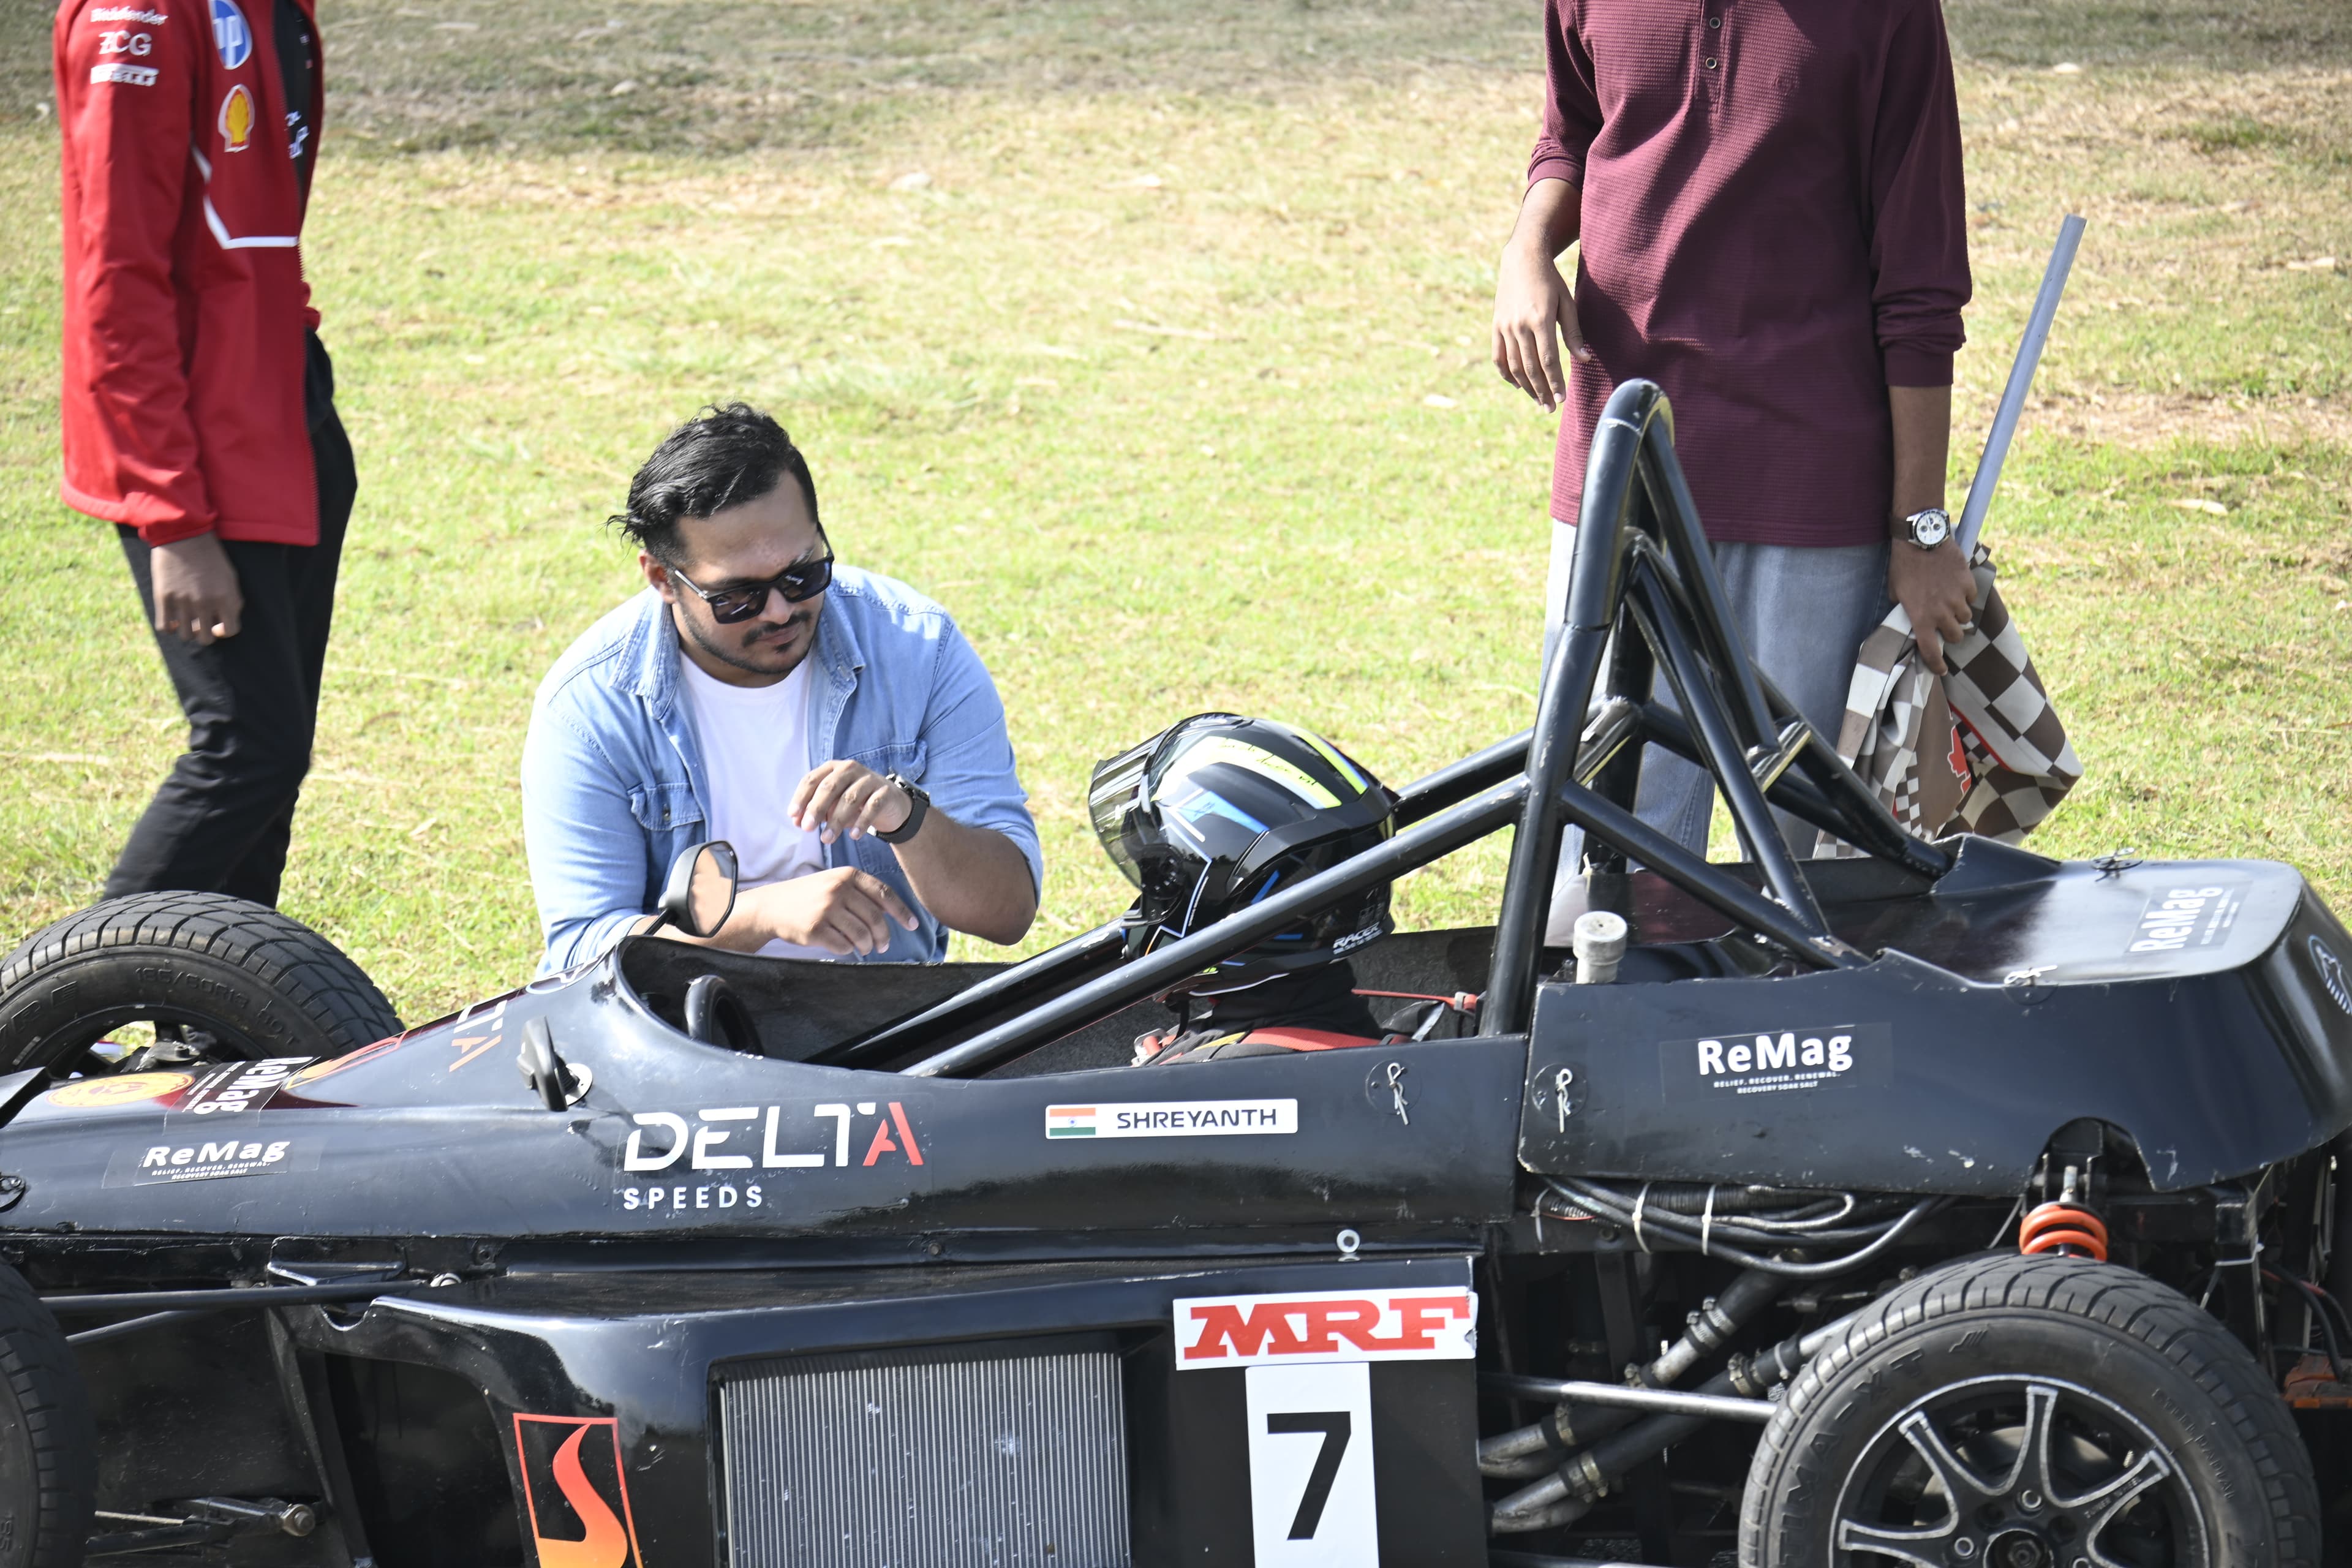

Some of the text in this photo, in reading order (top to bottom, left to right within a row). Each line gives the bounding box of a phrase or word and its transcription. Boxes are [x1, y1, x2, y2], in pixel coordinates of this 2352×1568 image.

[2130, 887, 2224, 952] ReMag
[1698, 1033, 1853, 1076] ReMag
[624, 1102, 924, 1171] DELTA
[1117, 1109, 1277, 1129] SHREYANTH
[143, 1140, 290, 1167] ReMag
[624, 1185, 763, 1210] SPEEDS
[1184, 1296, 1471, 1360] MRF
[1267, 1411, 1351, 1540] 7
